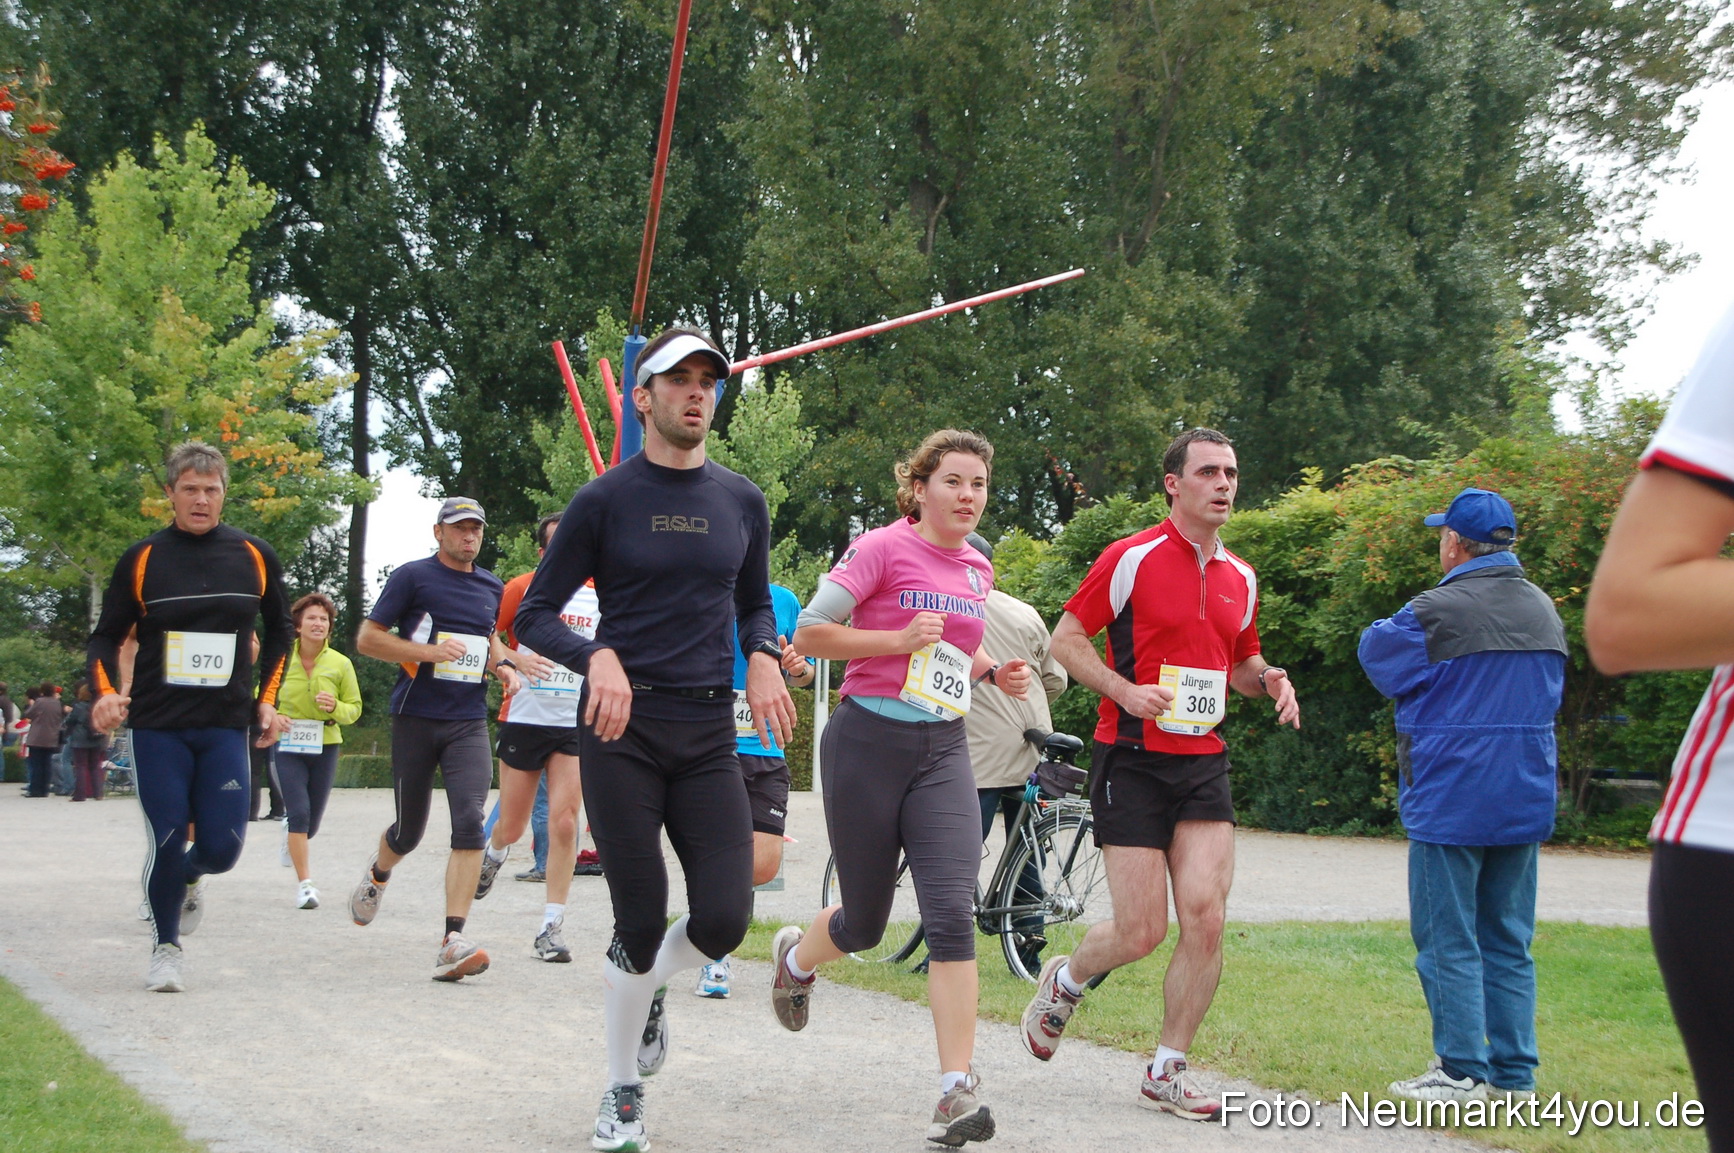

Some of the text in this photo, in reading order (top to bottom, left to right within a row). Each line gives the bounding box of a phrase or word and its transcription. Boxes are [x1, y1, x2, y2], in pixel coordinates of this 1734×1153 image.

[652, 515, 709, 530] R&D
[192, 654, 223, 669] 970
[457, 654, 480, 667] 999
[912, 659, 918, 670] C
[932, 671, 964, 699] 929
[1181, 674, 1213, 691] Jürgen
[1186, 695, 1216, 715] 308
[293, 731, 317, 741] 3261
